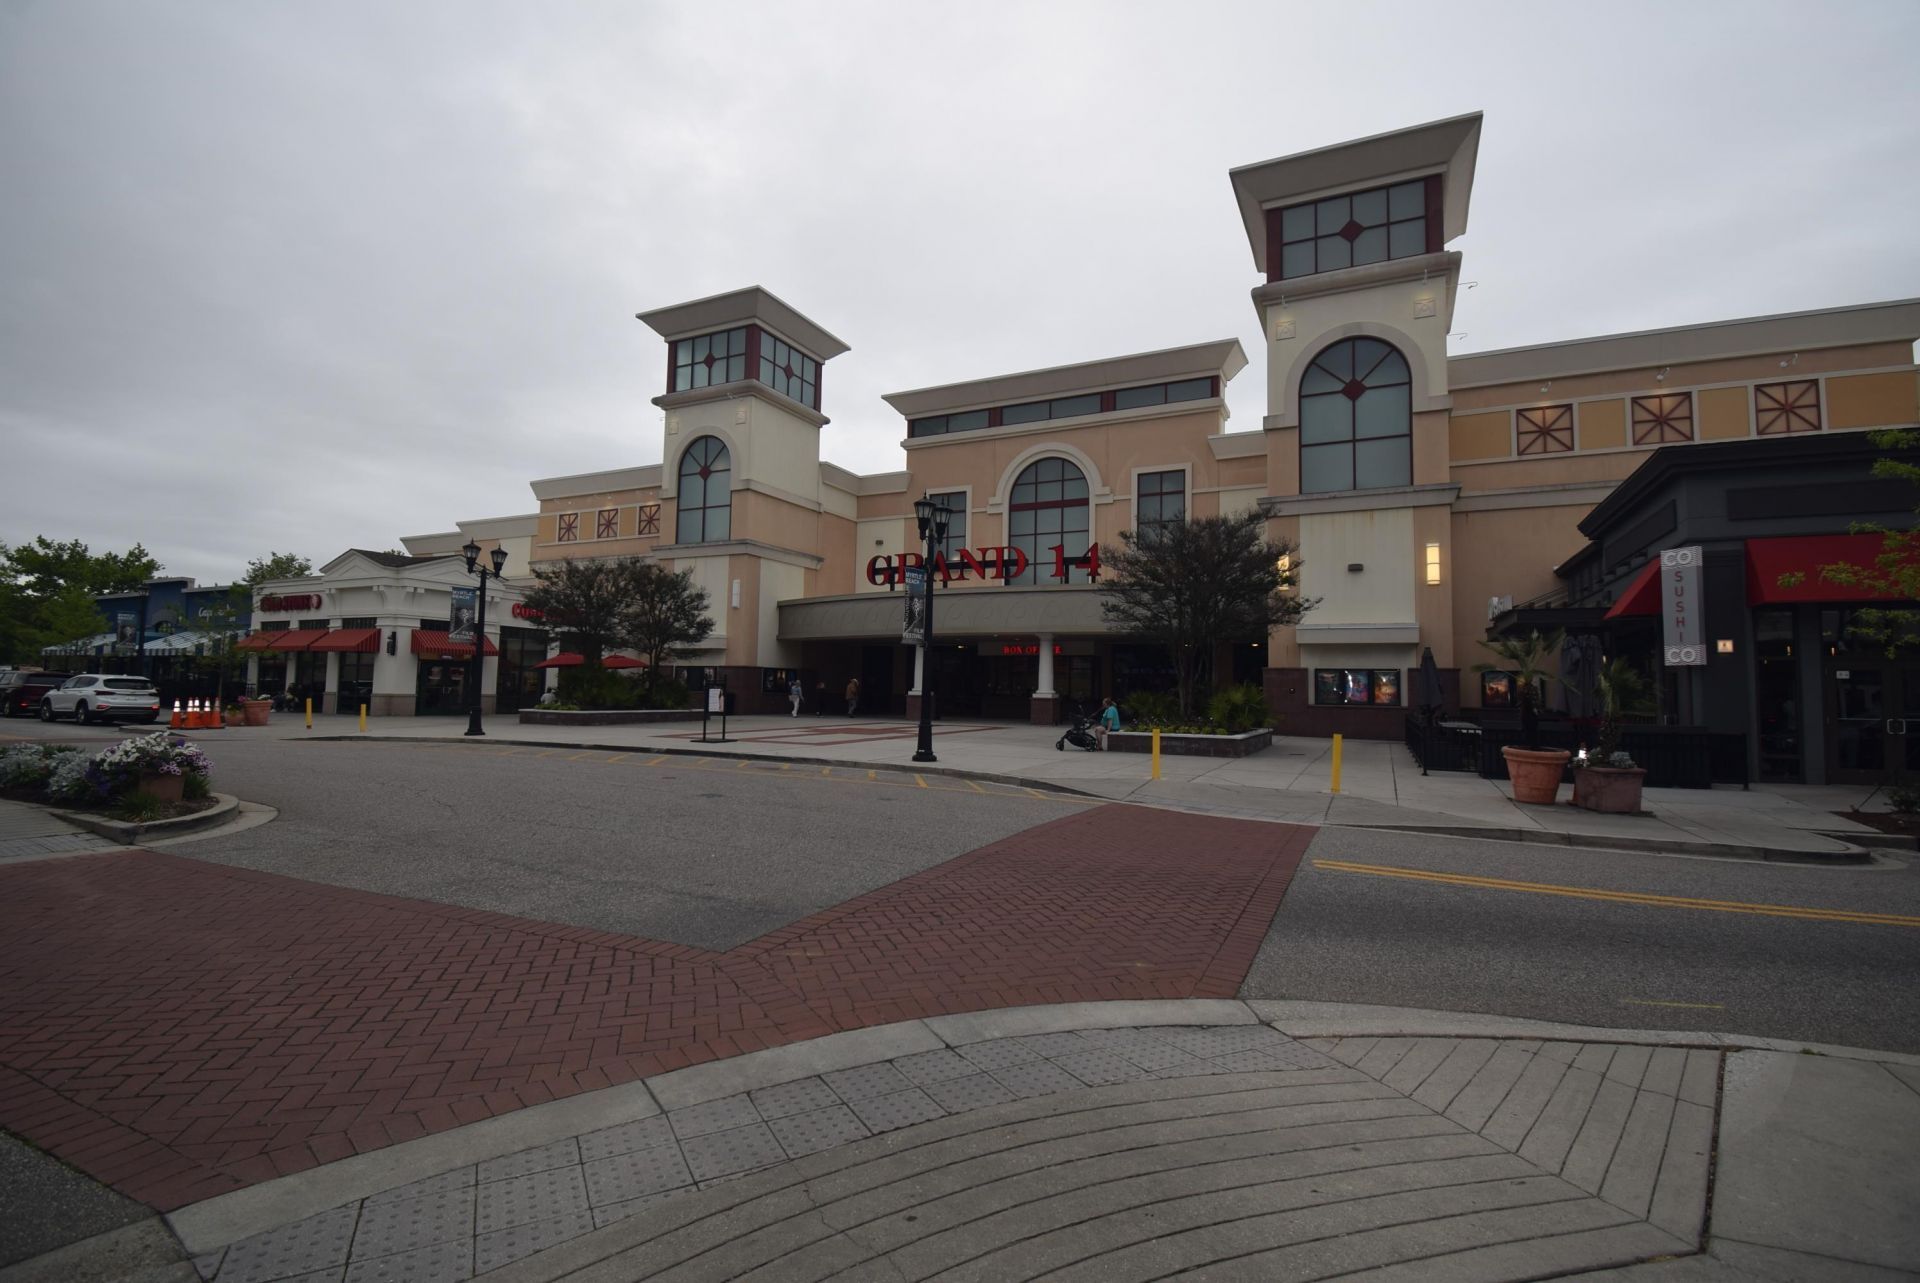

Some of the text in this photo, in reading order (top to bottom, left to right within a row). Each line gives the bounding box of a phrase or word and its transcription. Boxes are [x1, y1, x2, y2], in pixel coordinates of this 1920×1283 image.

[867, 541, 1102, 586] GRAND 14
[1663, 550, 1692, 566] CO
[1674, 570, 1686, 642] SUSHI
[1003, 645, 1063, 655] BOX OFE
[1667, 647, 1696, 664] CO
